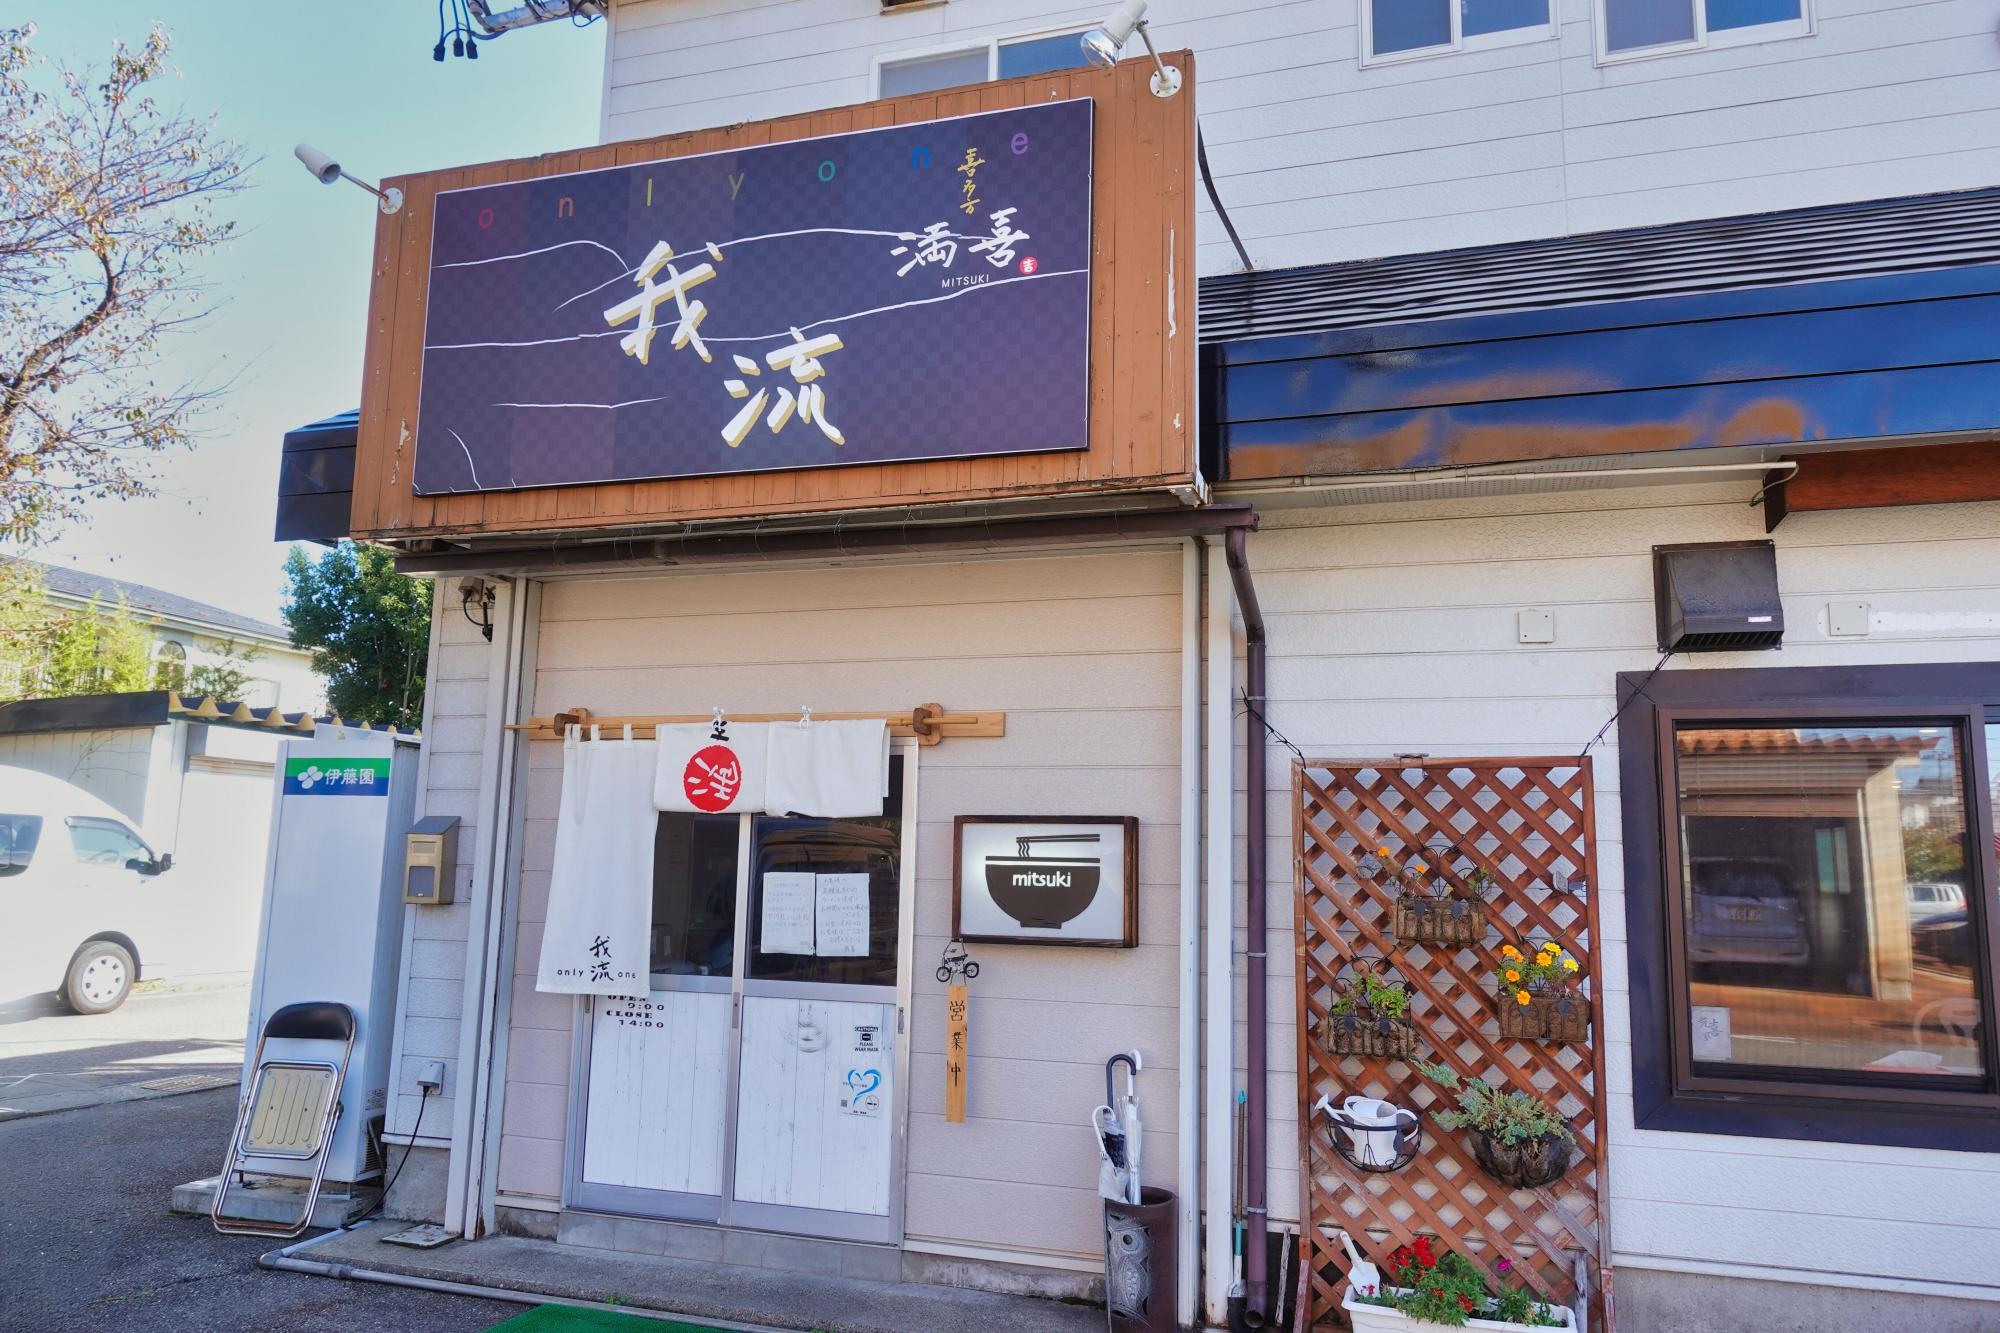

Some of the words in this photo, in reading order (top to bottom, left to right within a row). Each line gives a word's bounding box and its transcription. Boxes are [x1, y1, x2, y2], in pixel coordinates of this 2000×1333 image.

[957, 147, 985, 215] 喜多方
[941, 274, 989, 289] MITSUKI
[325, 768, 375, 785] 伊藤園
[1012, 870, 1071, 888] mitsuki
[589, 935, 615, 982] 我流
[557, 967, 584, 977] only
[617, 971, 637, 979] one
[606, 1010, 653, 1019] CLOSE
[618, 1020, 664, 1028] 14:00
[949, 1000, 966, 1087] 営業中
